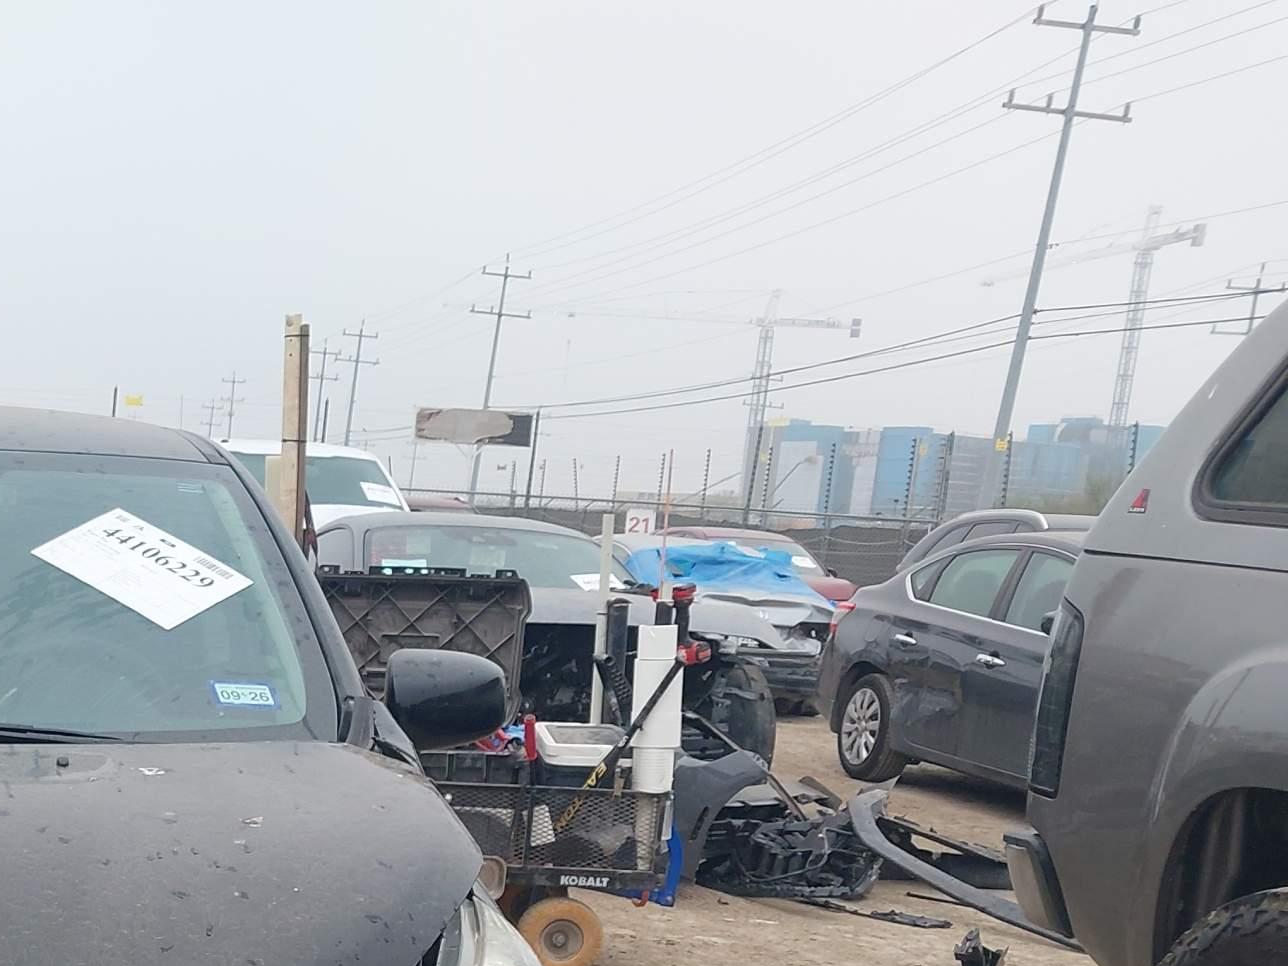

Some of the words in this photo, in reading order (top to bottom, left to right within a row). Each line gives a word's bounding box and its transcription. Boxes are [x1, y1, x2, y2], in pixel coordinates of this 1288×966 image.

[628, 516, 650, 534] 21
[103, 528, 215, 588] 44106229
[220, 690, 241, 701] 09
[248, 691, 270, 702] 26
[553, 761, 608, 832] EATON
[560, 875, 610, 887] KOBALT
